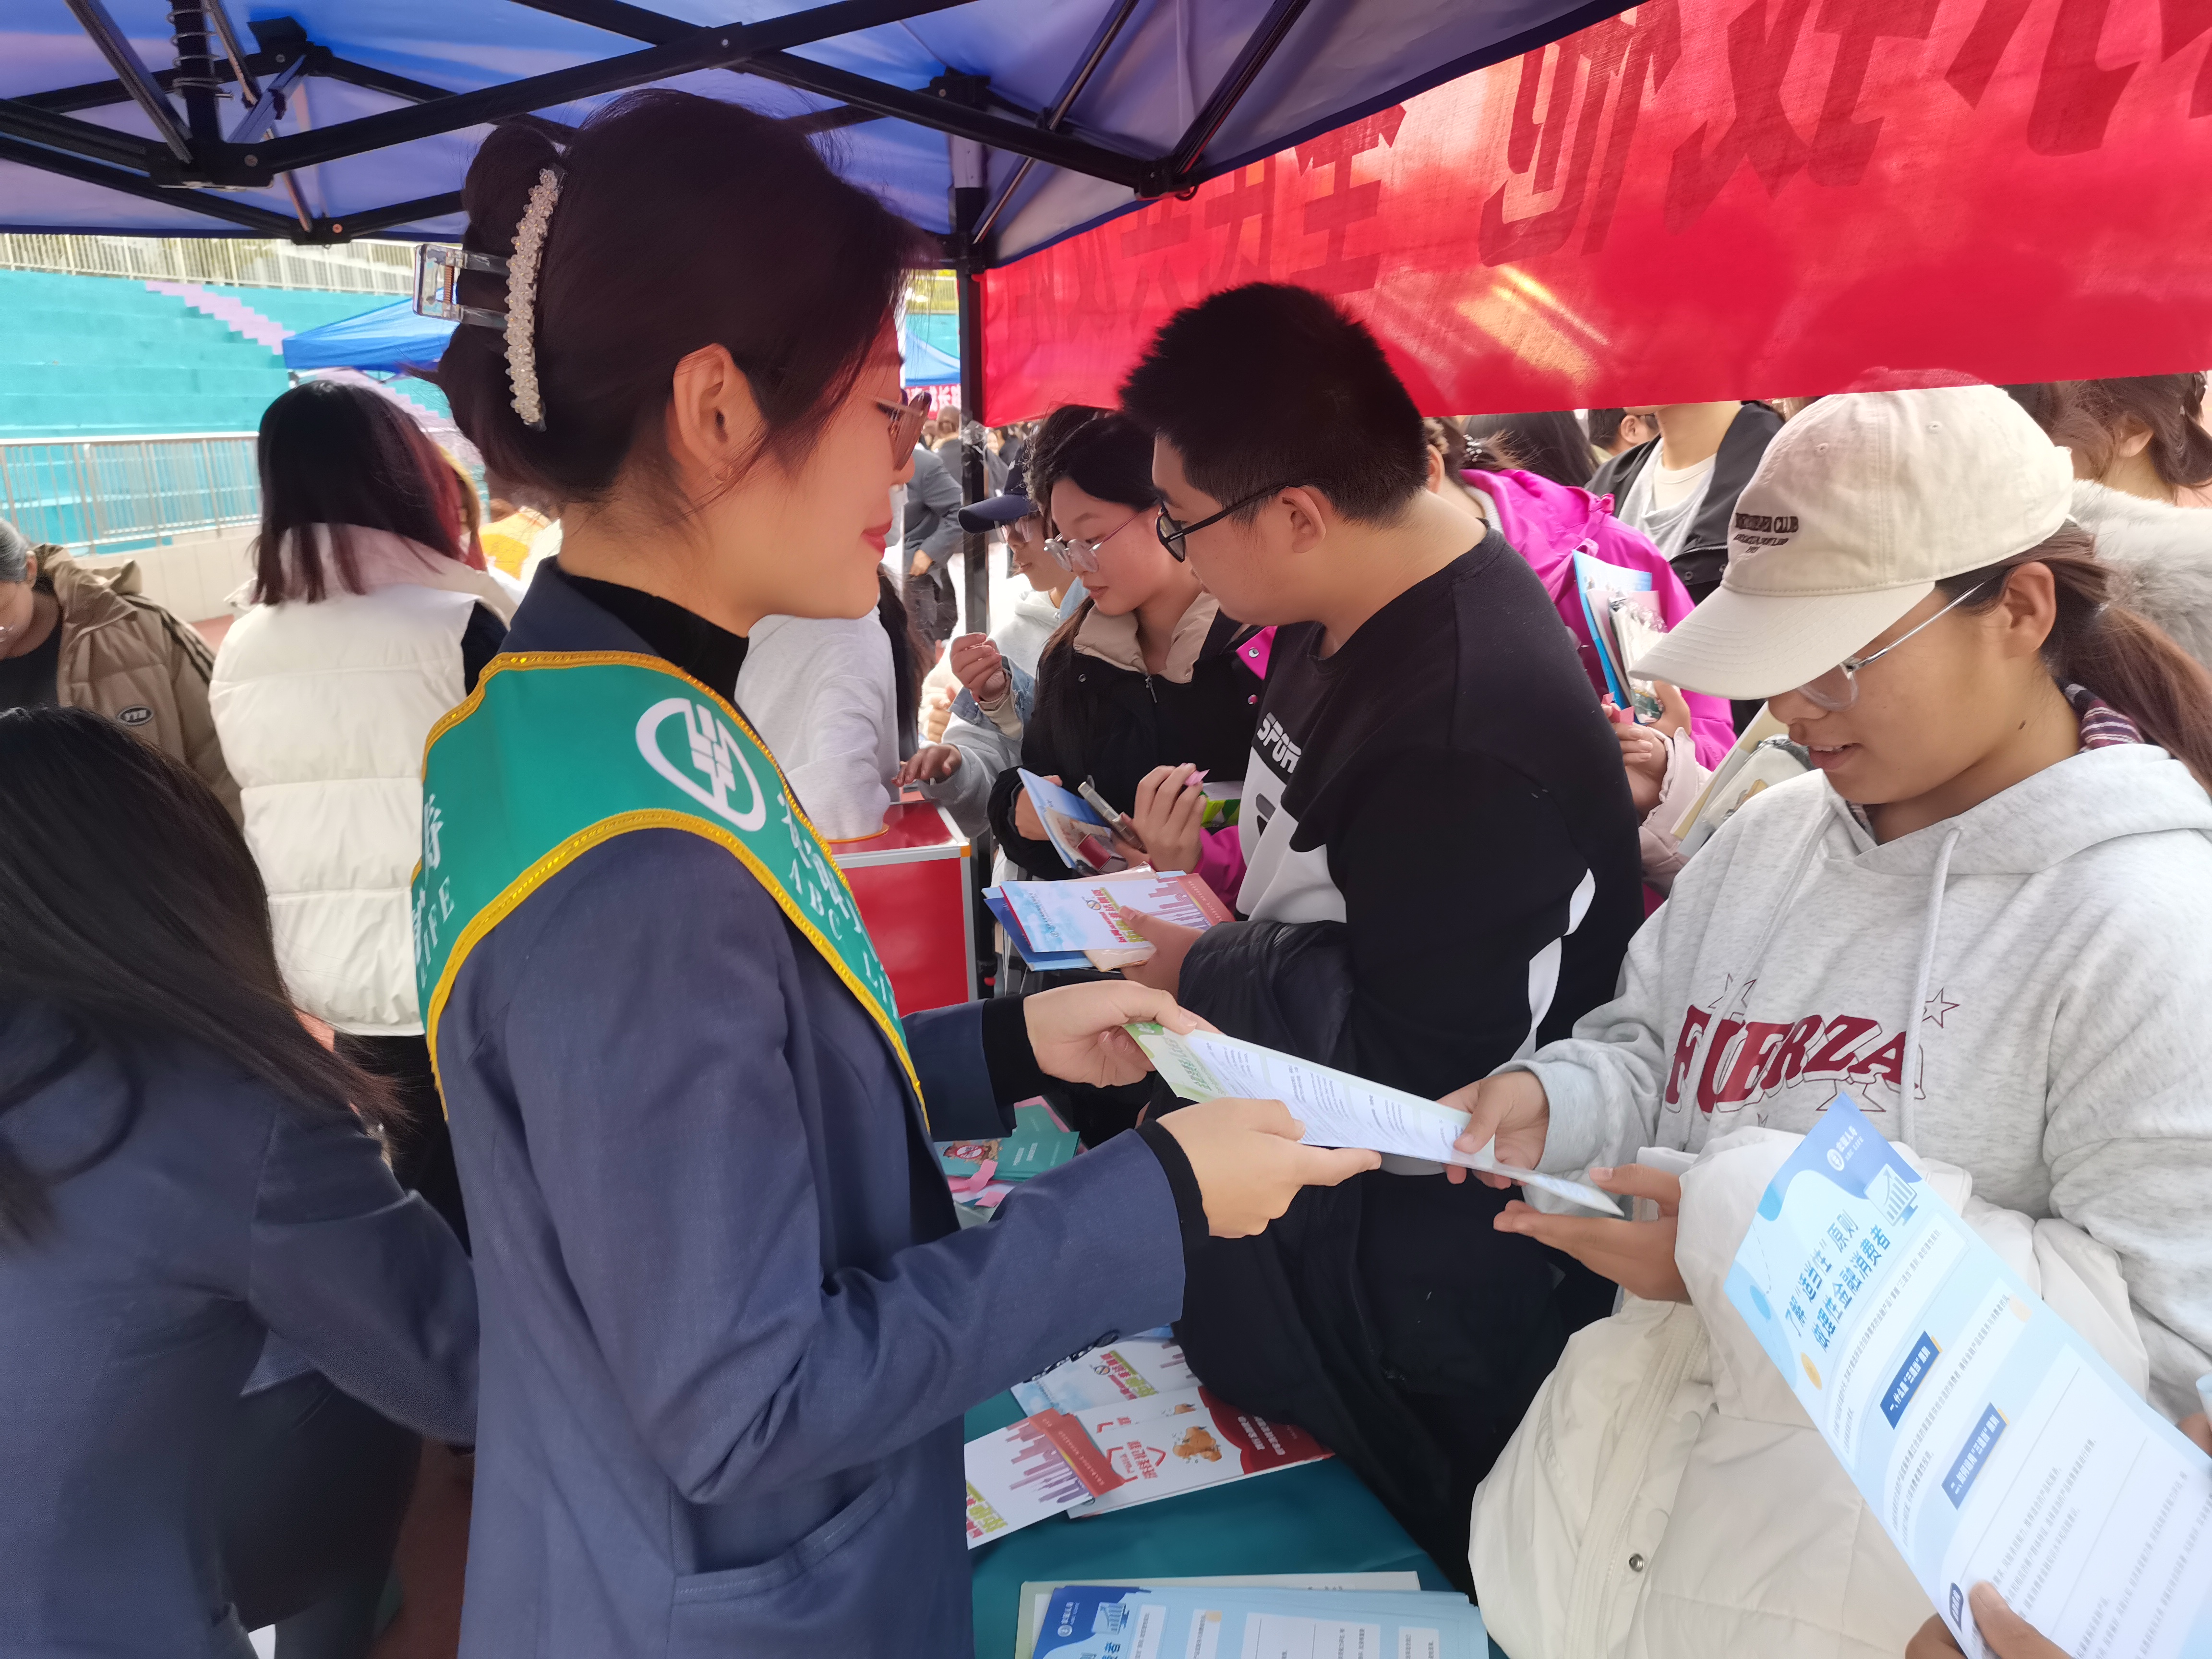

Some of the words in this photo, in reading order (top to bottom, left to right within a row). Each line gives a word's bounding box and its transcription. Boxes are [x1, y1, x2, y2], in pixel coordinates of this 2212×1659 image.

[789, 858, 843, 941] ABC
[1664, 1003, 1919, 1118] FUERZA
[1814, 1224, 1892, 1354] 做理性金融消费者
